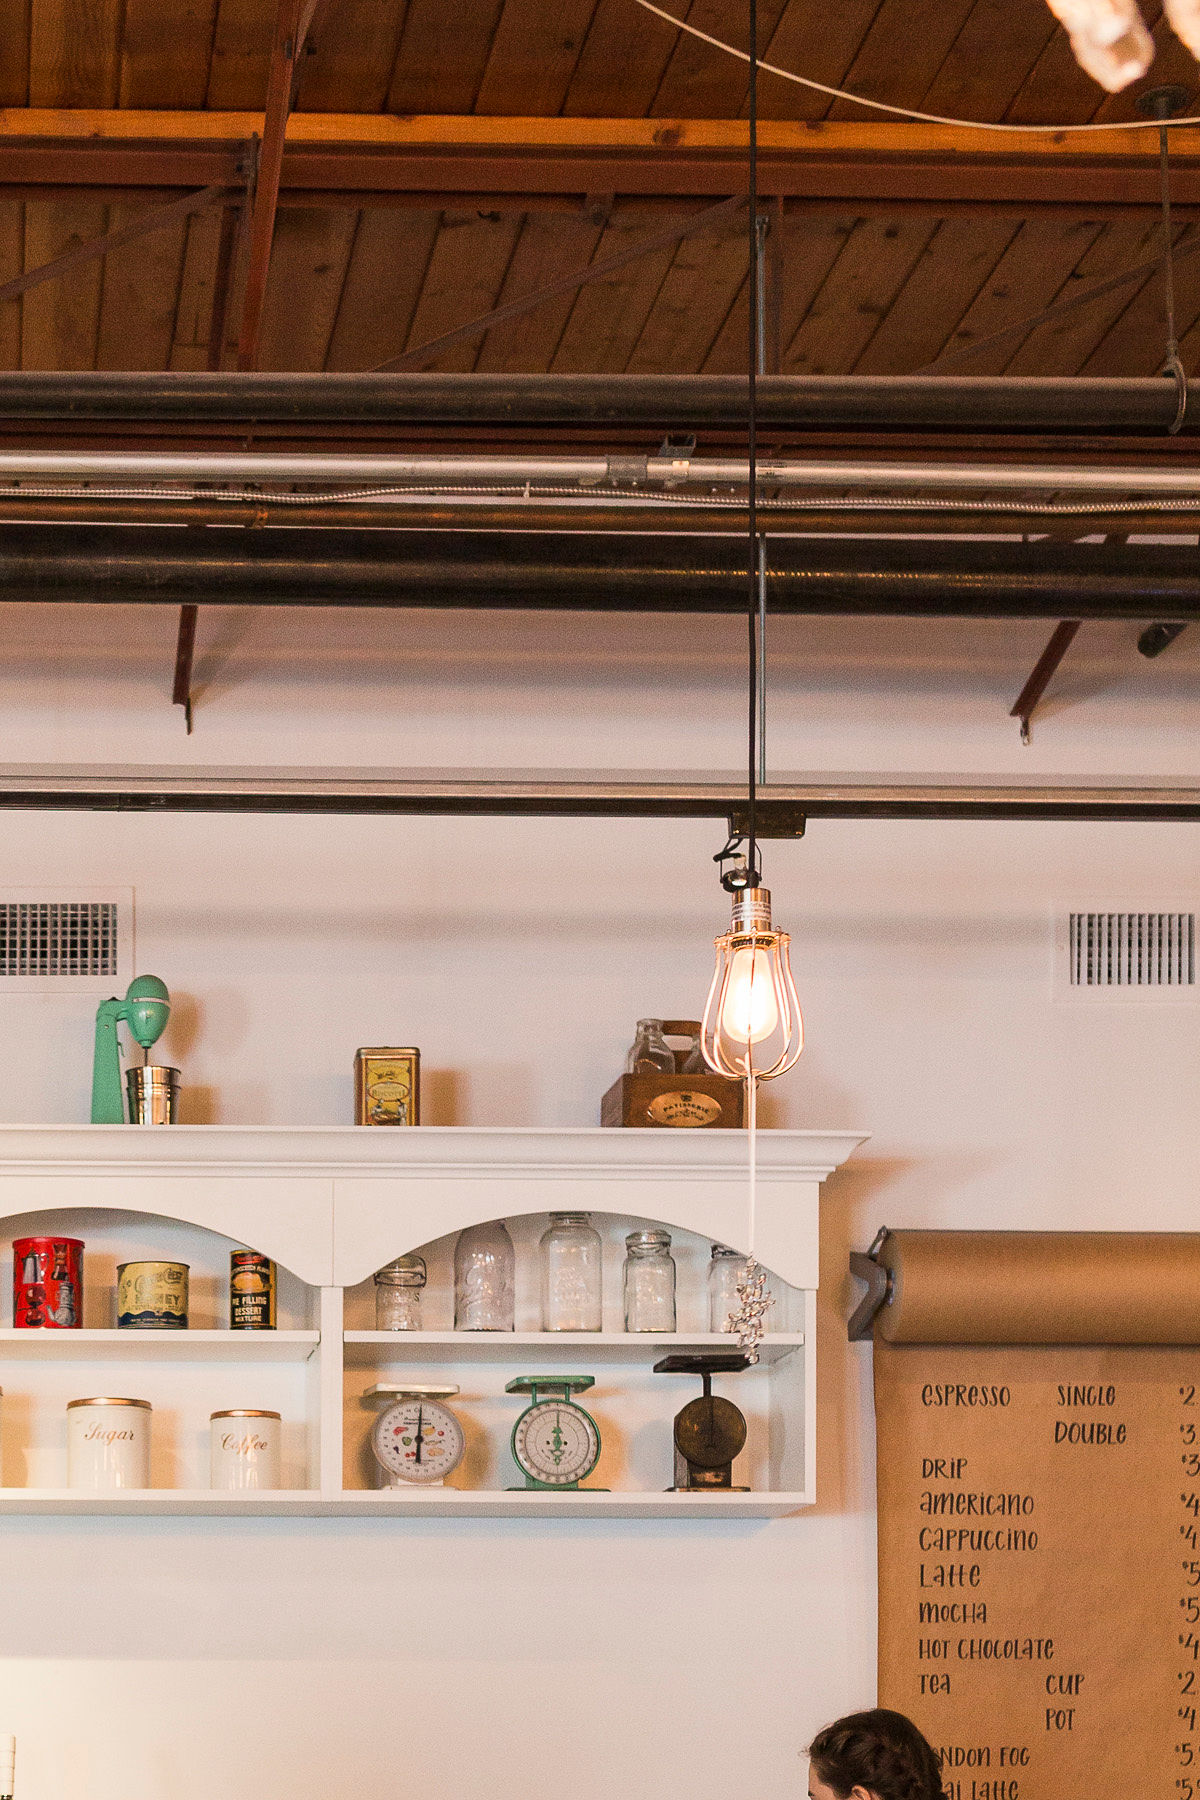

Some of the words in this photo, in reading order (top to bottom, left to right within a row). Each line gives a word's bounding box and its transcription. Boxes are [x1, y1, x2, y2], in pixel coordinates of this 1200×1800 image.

[83, 1420, 135, 1448] Sugar
[220, 1432, 268, 1456] Coffee
[1045, 1674, 1085, 1695] CUP
[1045, 1708, 1076, 1731] POT
[999, 1746, 1030, 1767] FOG
